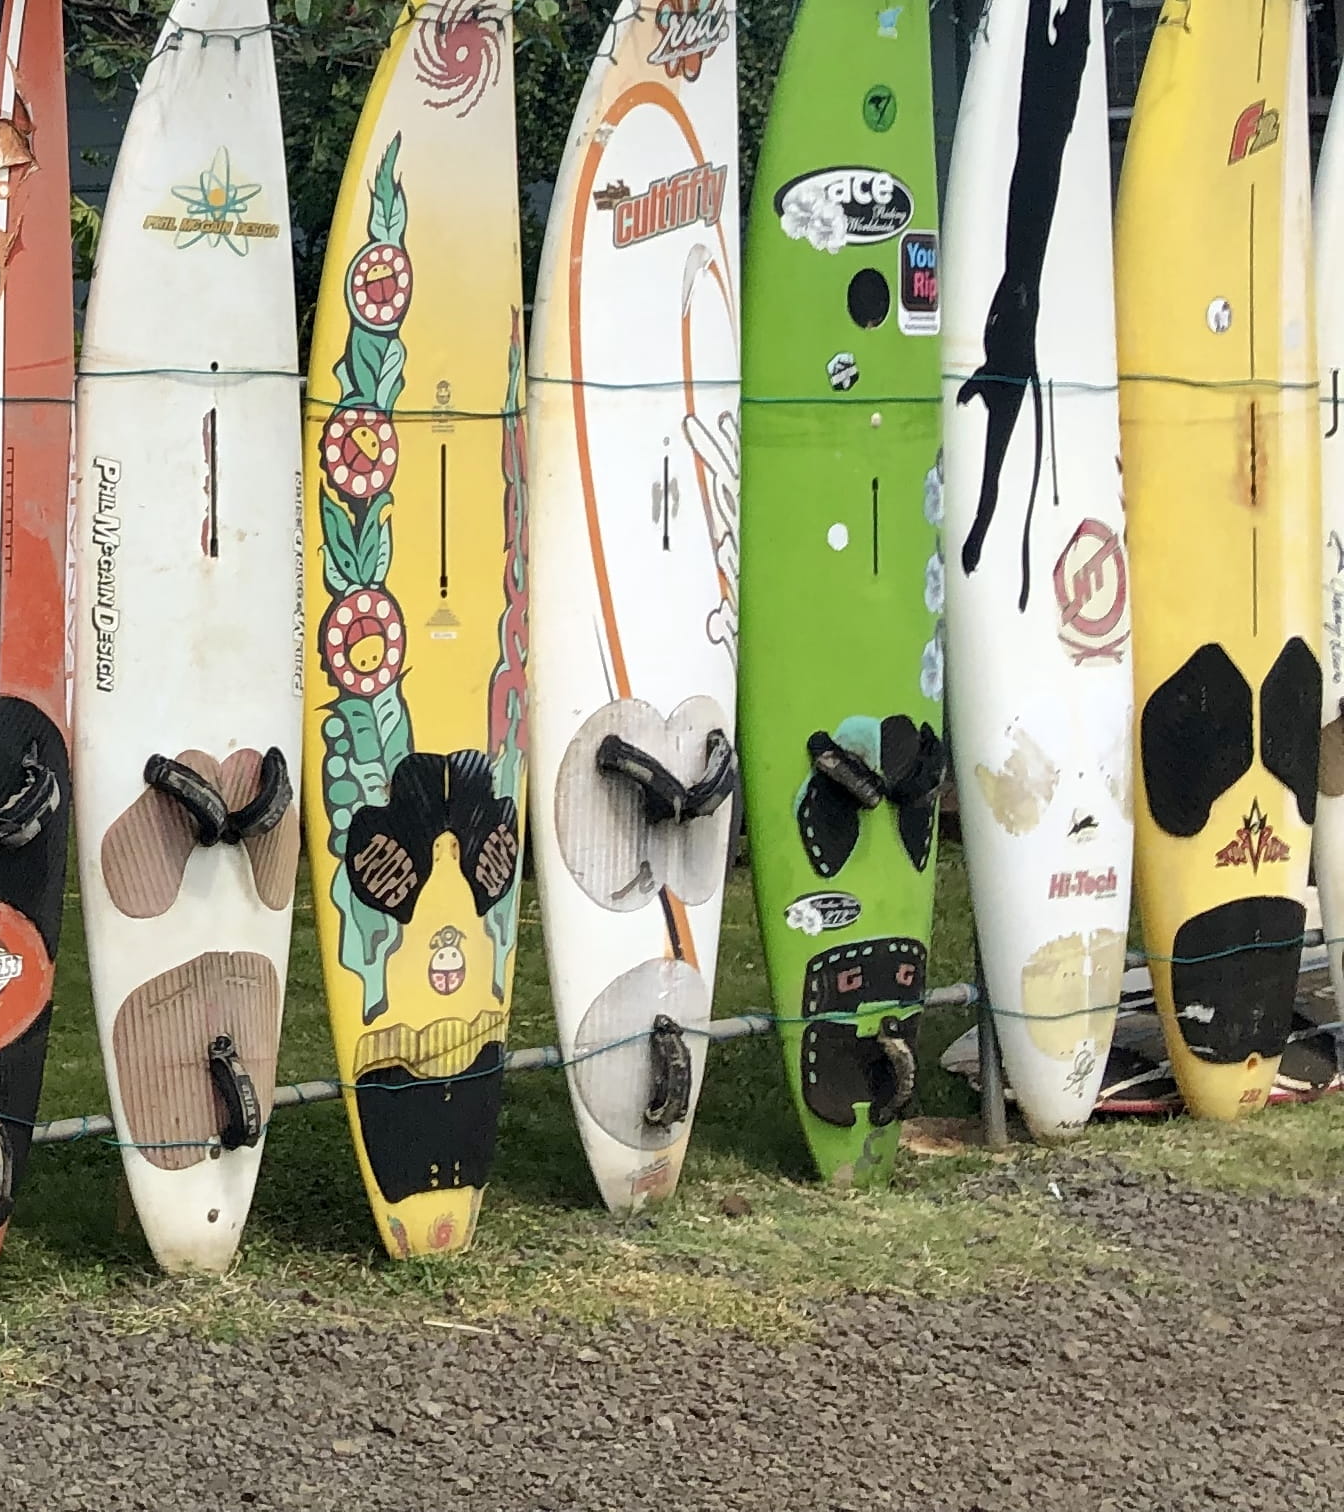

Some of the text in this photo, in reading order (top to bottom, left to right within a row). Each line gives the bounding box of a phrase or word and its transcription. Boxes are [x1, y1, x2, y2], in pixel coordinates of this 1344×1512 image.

[1228, 99, 1280, 166] F2
[826, 173, 894, 205] ace
[143, 215, 177, 232] PHIL
[907, 241, 937, 269] You
[93, 455, 122, 513] PHIL
[91, 604, 121, 693] DESIGN
[1048, 866, 1118, 900] Hi-Tech
